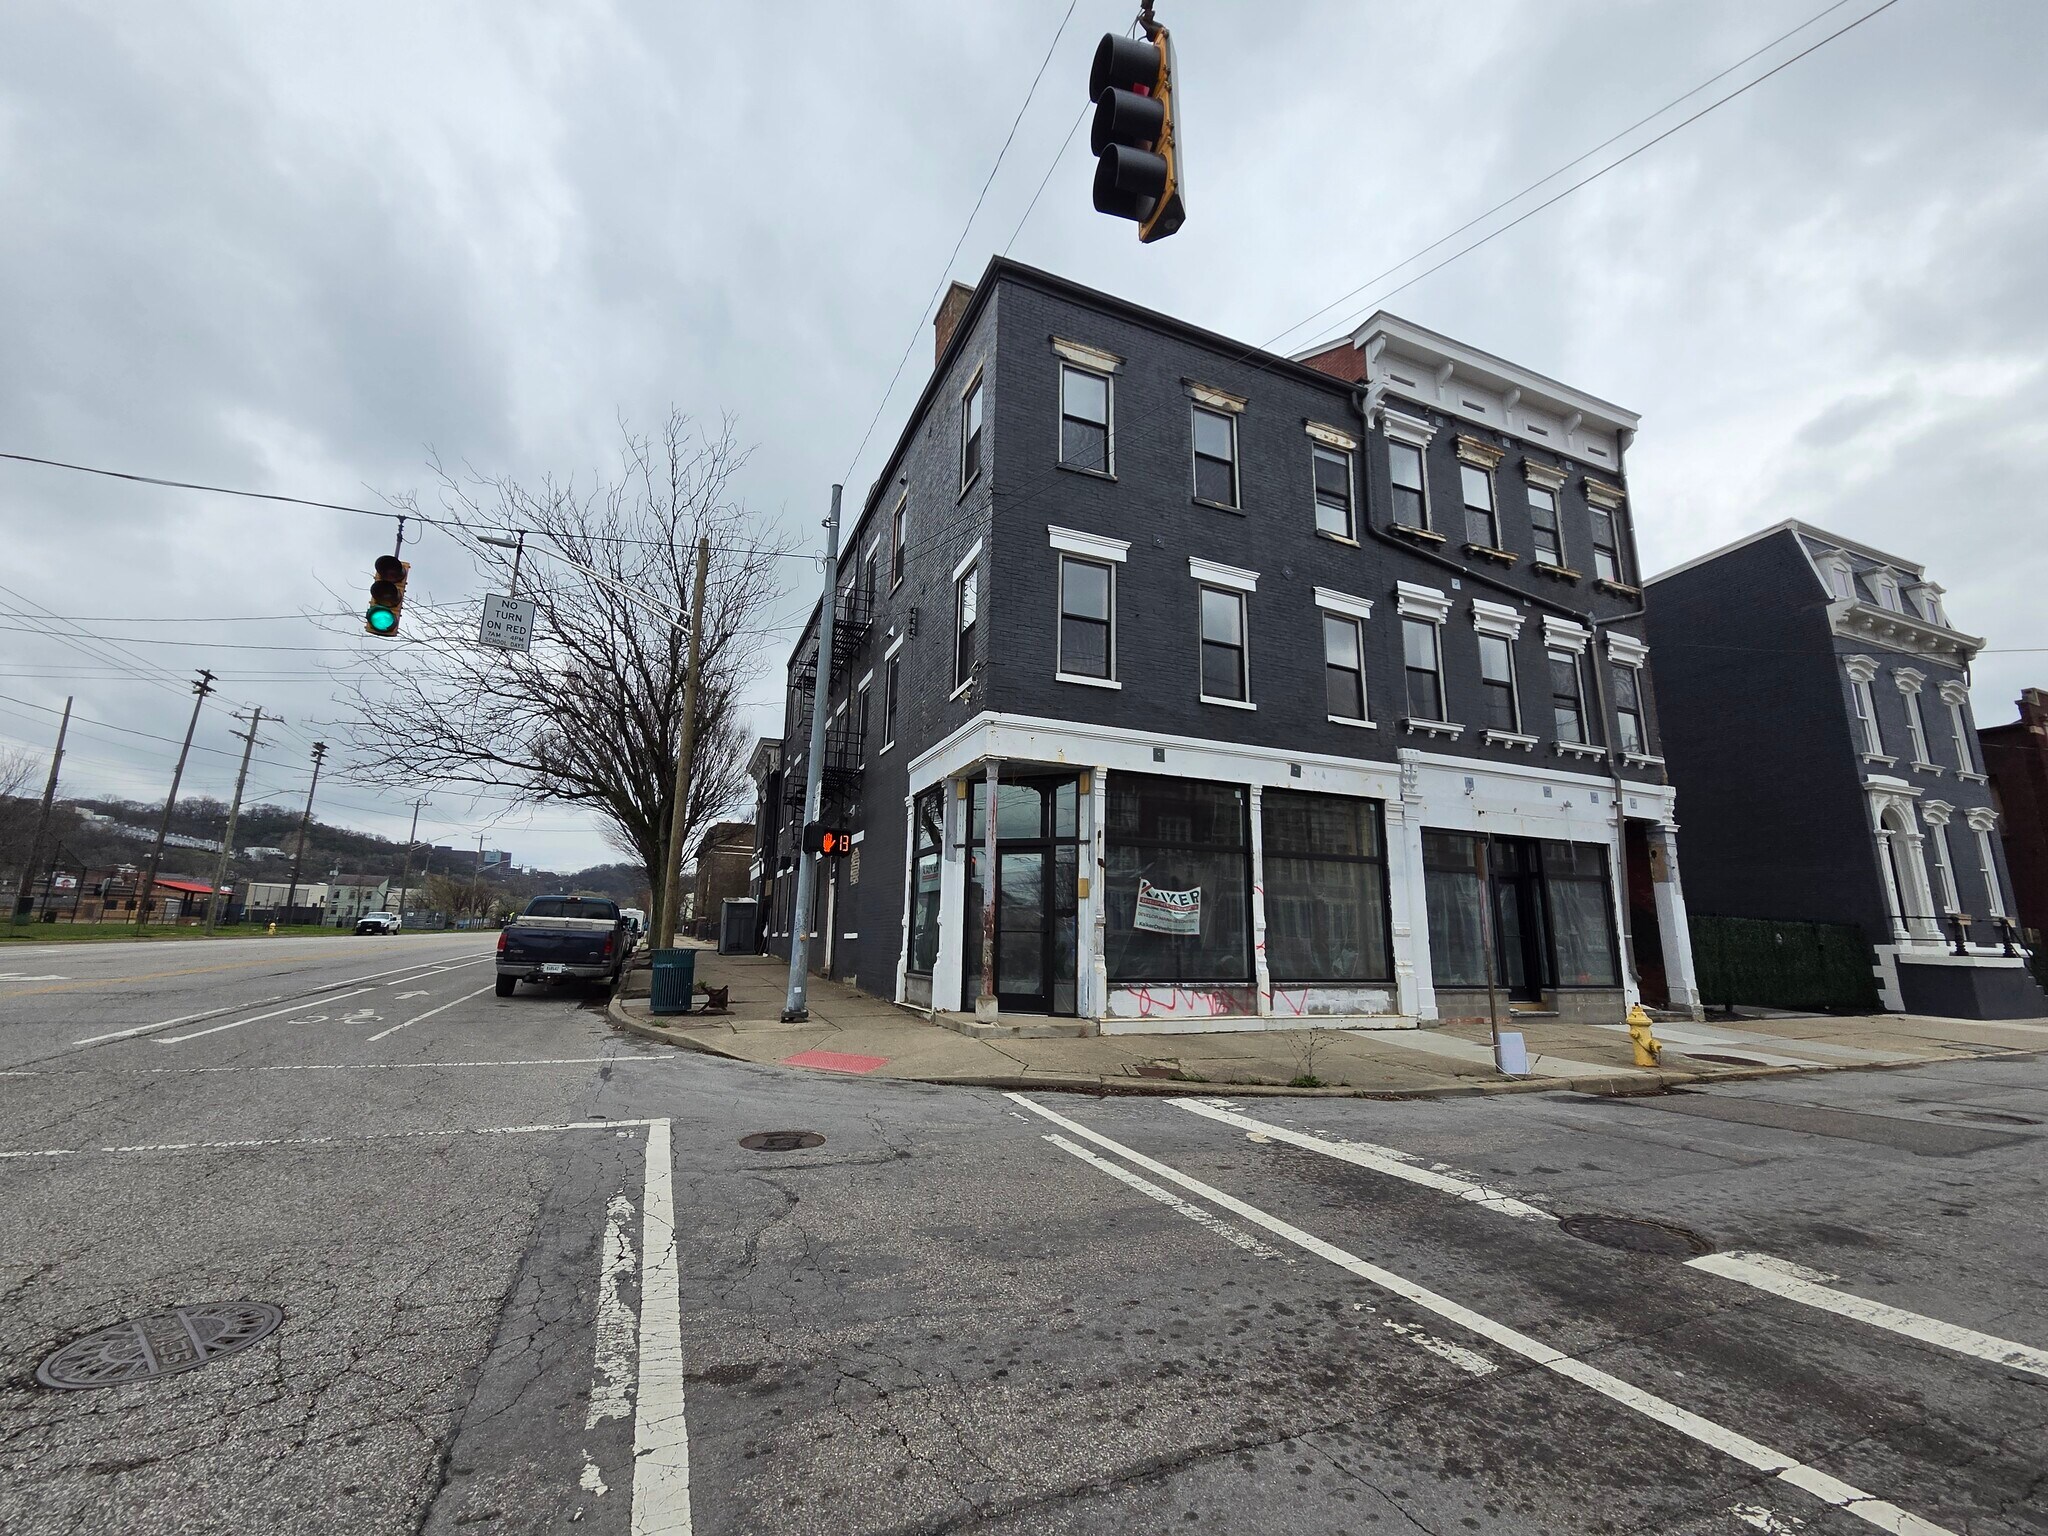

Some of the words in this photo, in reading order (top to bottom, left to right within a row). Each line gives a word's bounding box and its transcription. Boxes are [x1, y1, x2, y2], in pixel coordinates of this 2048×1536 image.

[501, 600, 518, 610] NO
[495, 610, 522, 622] TURN
[487, 620, 501, 630] ON
[506, 624, 527, 634] RED
[484, 637, 507, 646] SCHOOL
[839, 835, 850, 852] 13
